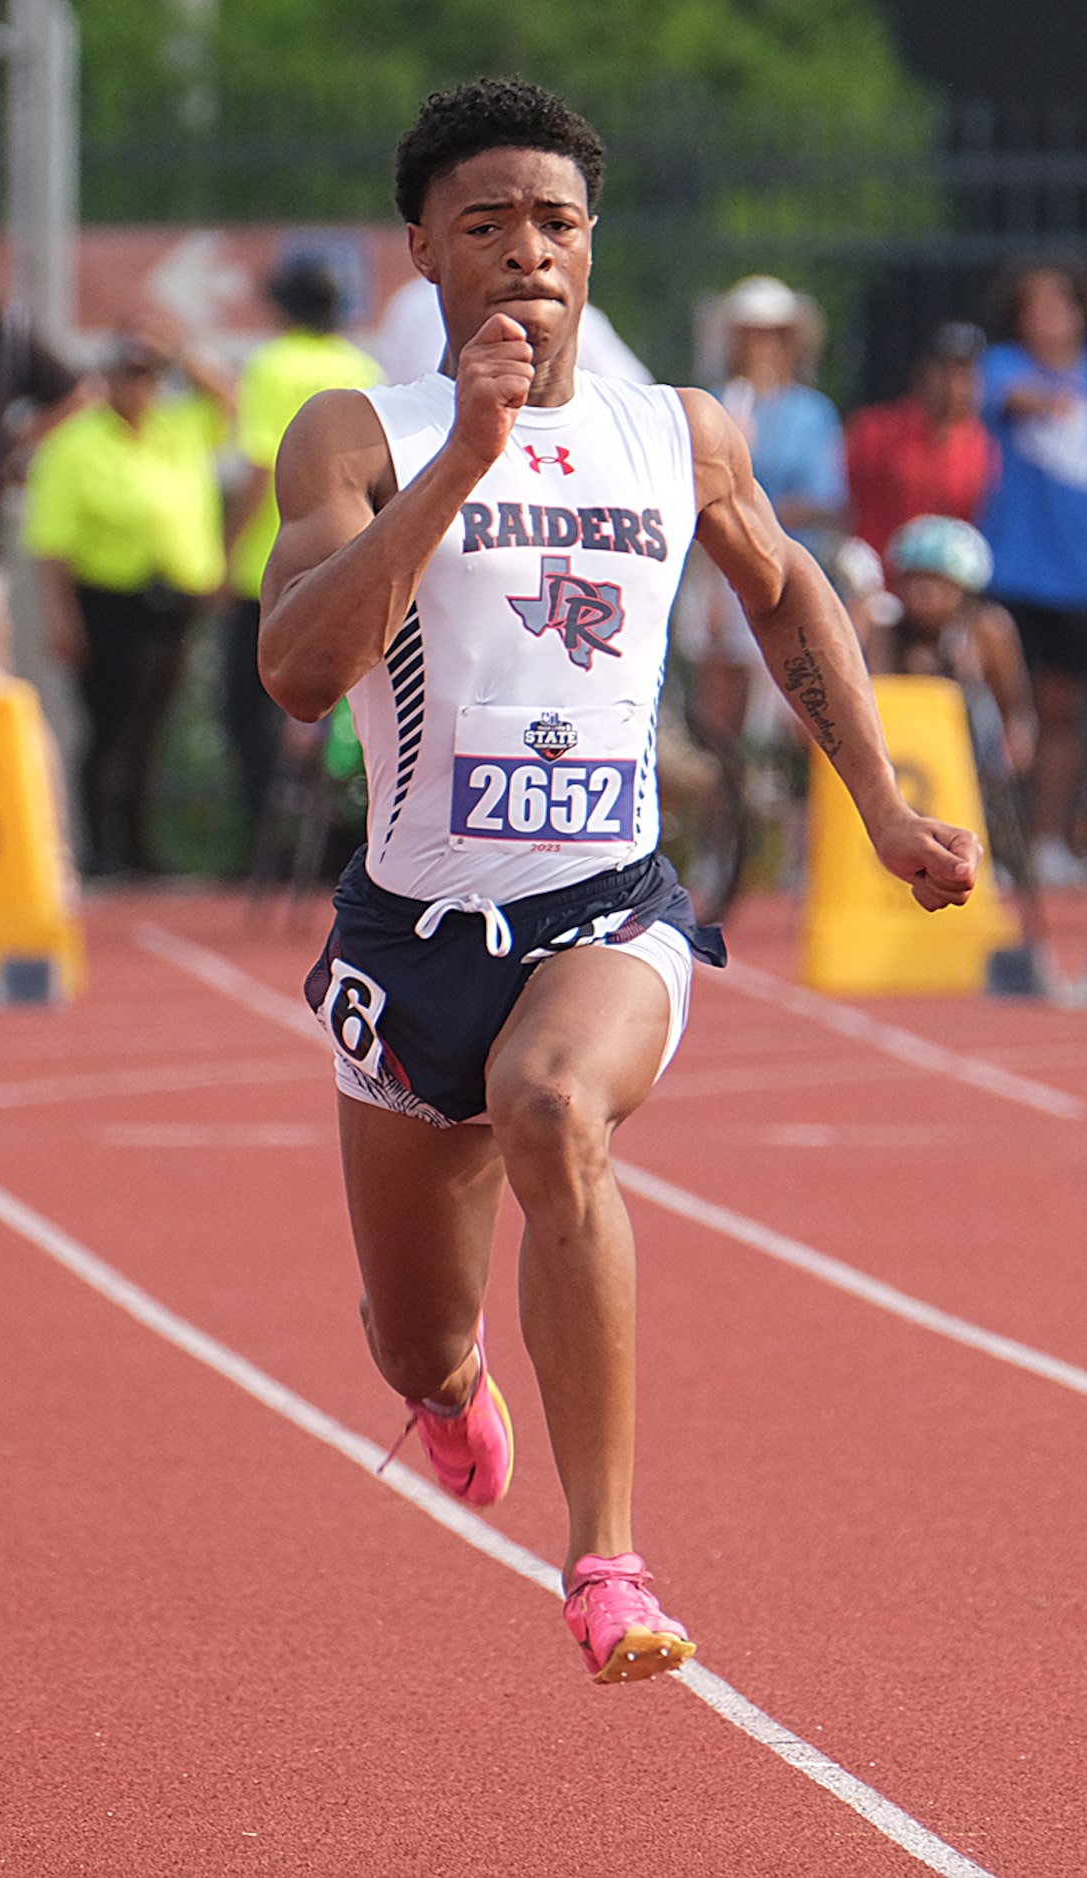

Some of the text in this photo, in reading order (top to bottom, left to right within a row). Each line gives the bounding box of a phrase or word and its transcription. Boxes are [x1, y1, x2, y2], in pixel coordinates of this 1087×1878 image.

[460, 502, 668, 562] RAIDERS
[524, 730, 577, 744] STATE
[466, 764, 622, 834] 2652
[529, 843, 561, 853] 2023
[331, 976, 373, 1062] 6
